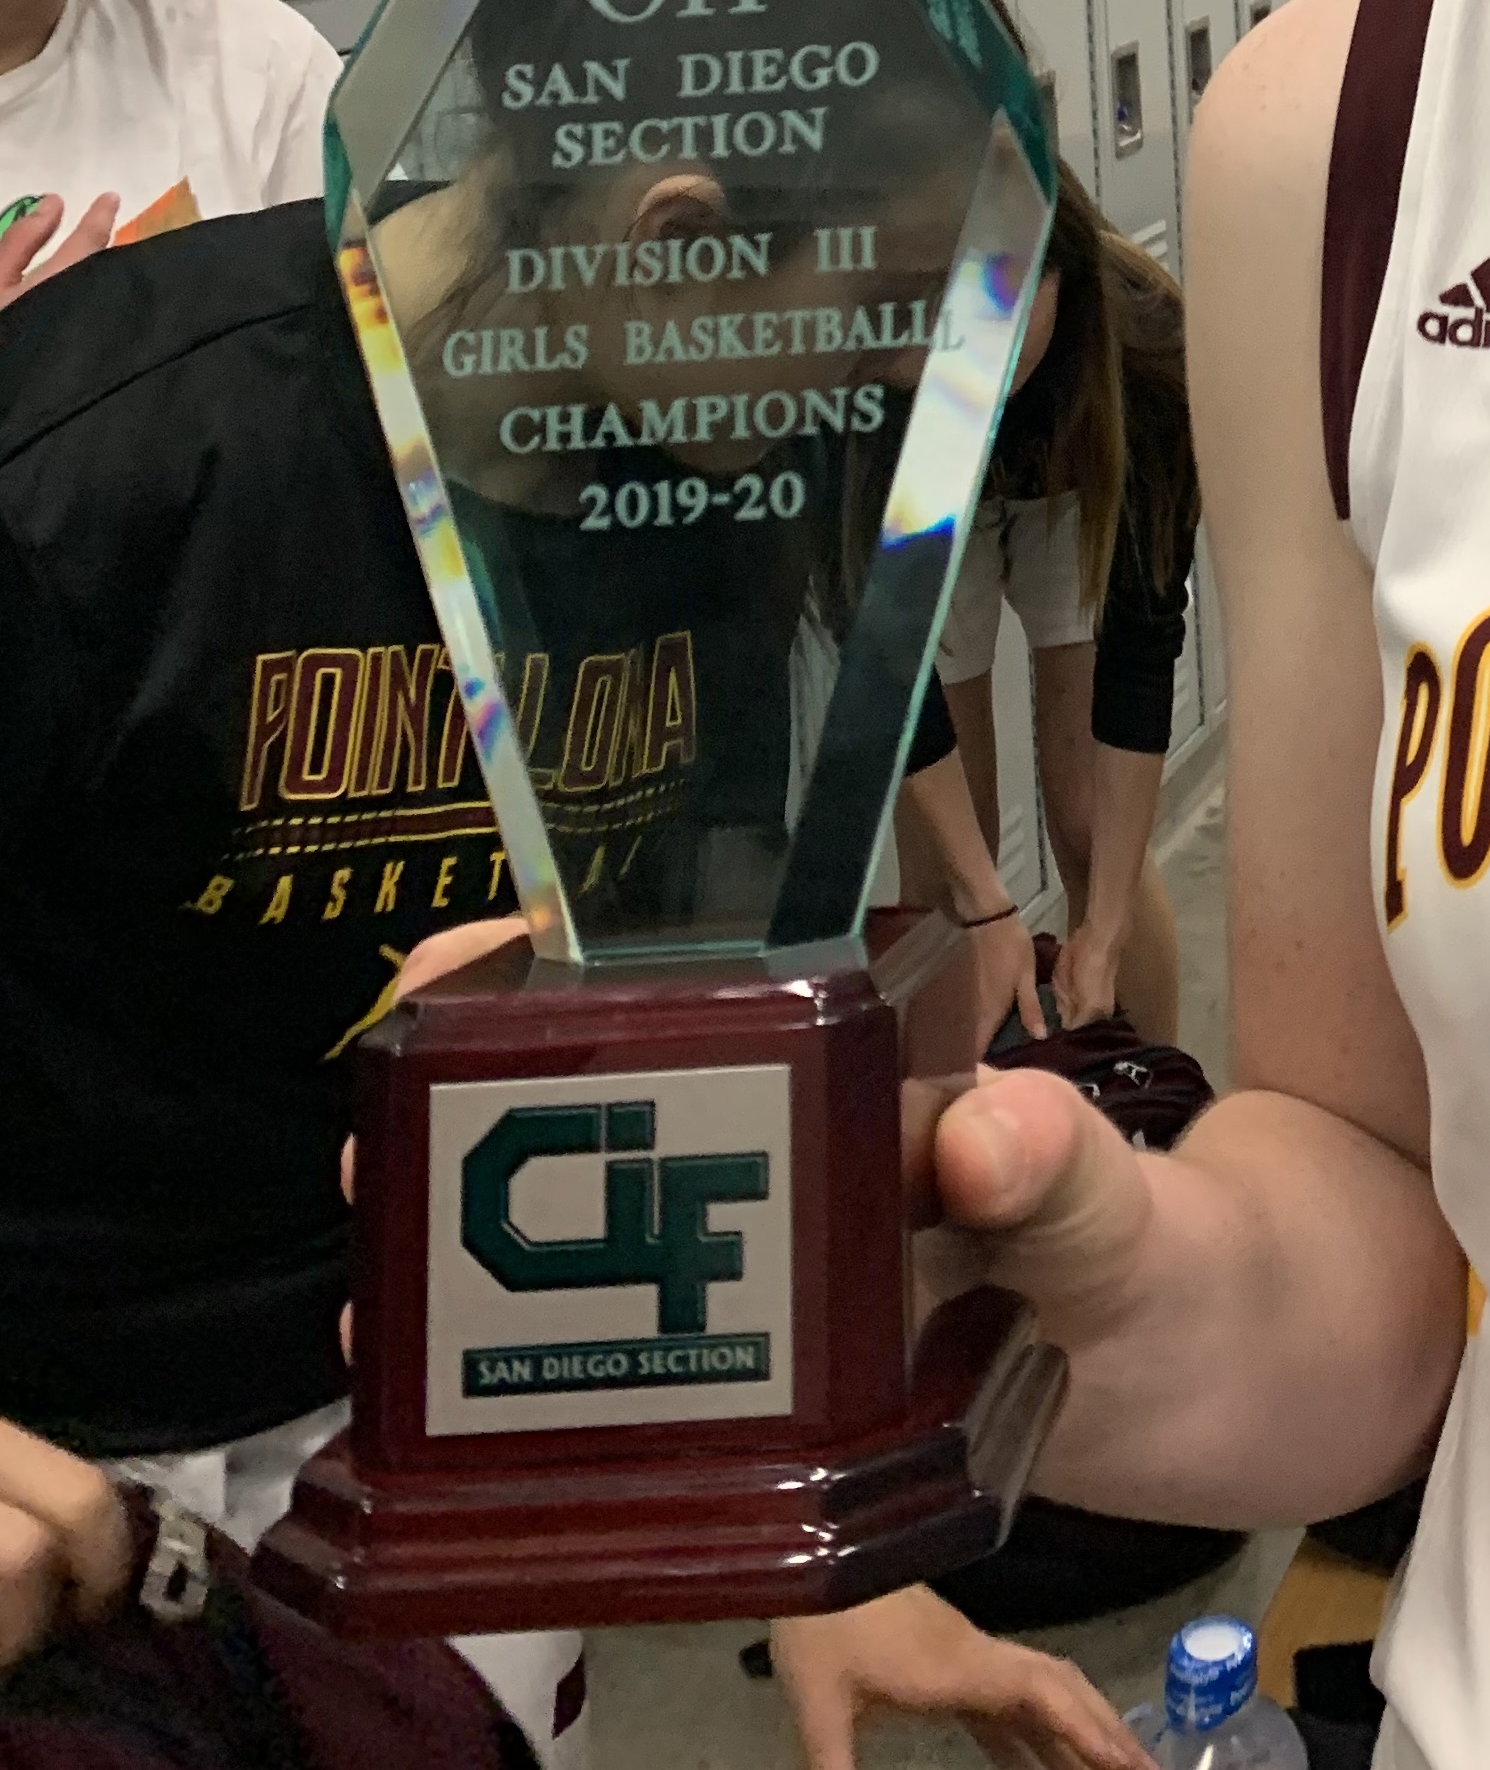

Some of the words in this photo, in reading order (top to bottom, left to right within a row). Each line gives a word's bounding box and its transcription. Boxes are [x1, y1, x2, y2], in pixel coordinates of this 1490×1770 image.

[501, 58, 632, 110] SAN
[676, 40, 880, 98] DIEGO
[551, 106, 829, 169] SECTION
[505, 231, 774, 295] DIVISION
[813, 225, 878, 274] III
[442, 323, 590, 378] GIRLS
[500, 383, 888, 455] CHAMPIONS
[578, 470, 807, 531] 2019-20
[477, 1357, 535, 1385] SAN
[542, 1352, 628, 1380] DIEGO
[637, 1344, 757, 1376] SECTION
